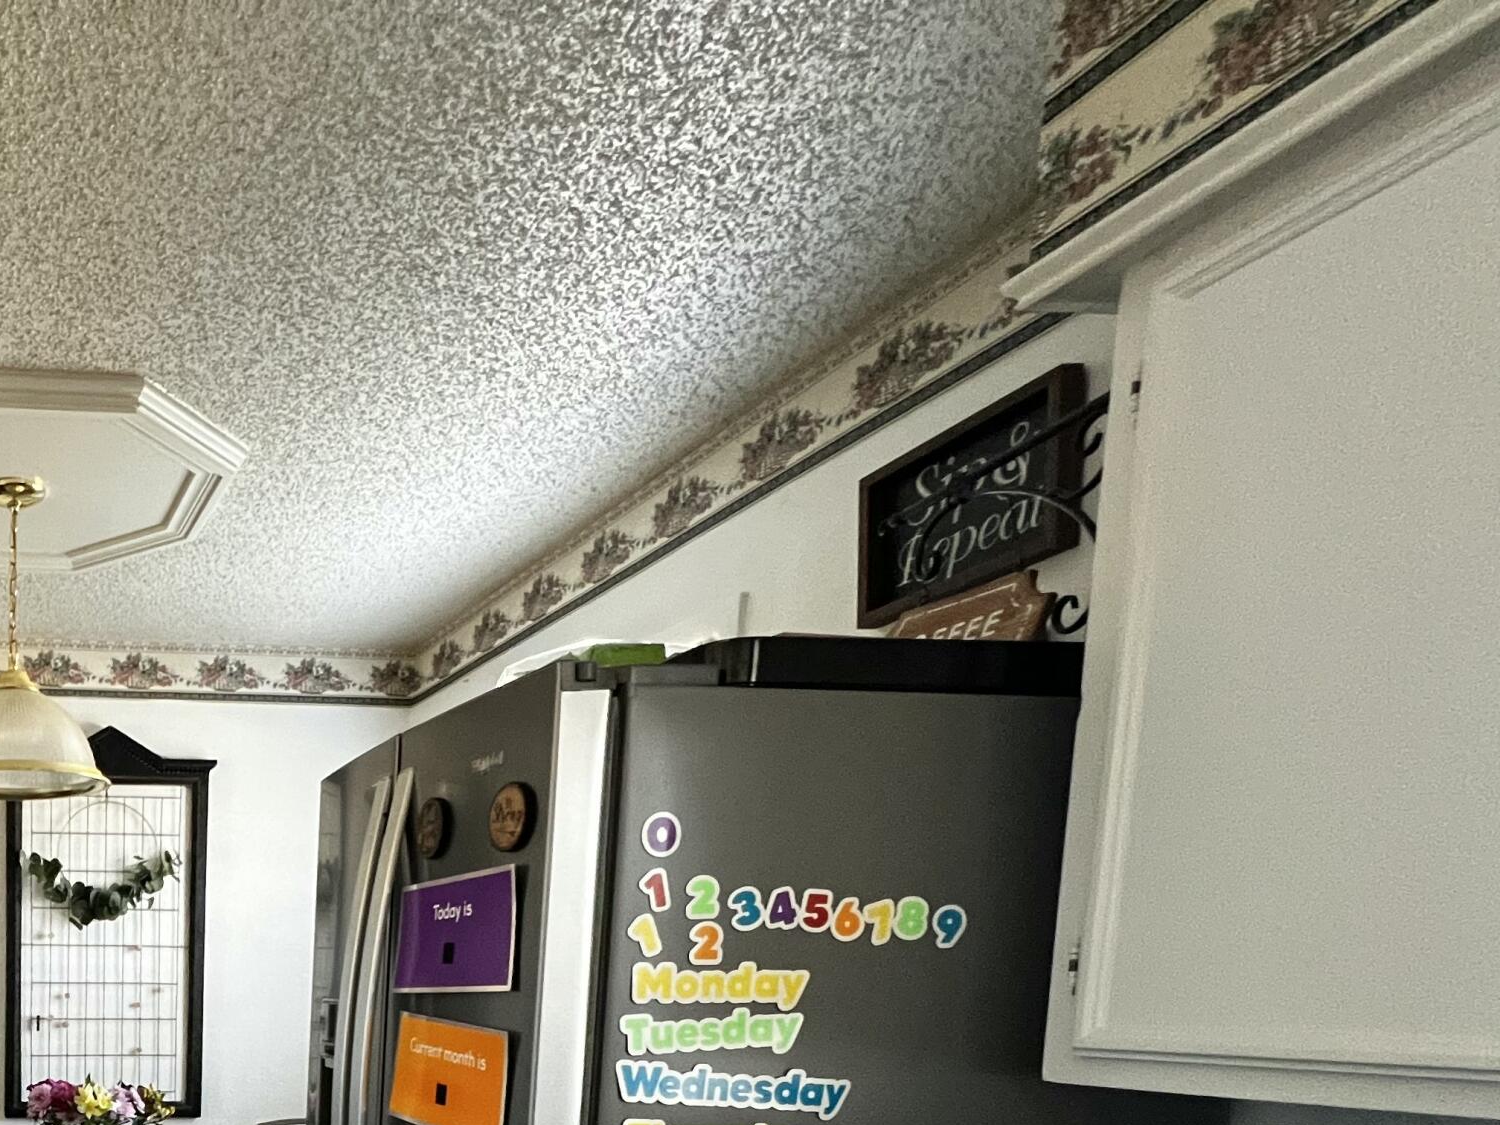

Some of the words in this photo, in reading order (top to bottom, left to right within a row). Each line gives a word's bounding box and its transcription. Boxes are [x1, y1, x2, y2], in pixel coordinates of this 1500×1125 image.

[432, 902, 461, 923] Today
[463, 902, 473, 918] is
[636, 964, 806, 1009] Monday
[624, 1011, 801, 1052] Tuesday
[410, 1036, 442, 1056] Current
[443, 1050, 475, 1068] month
[477, 1055, 487, 1071] is
[621, 1064, 847, 1116] Wednesday
